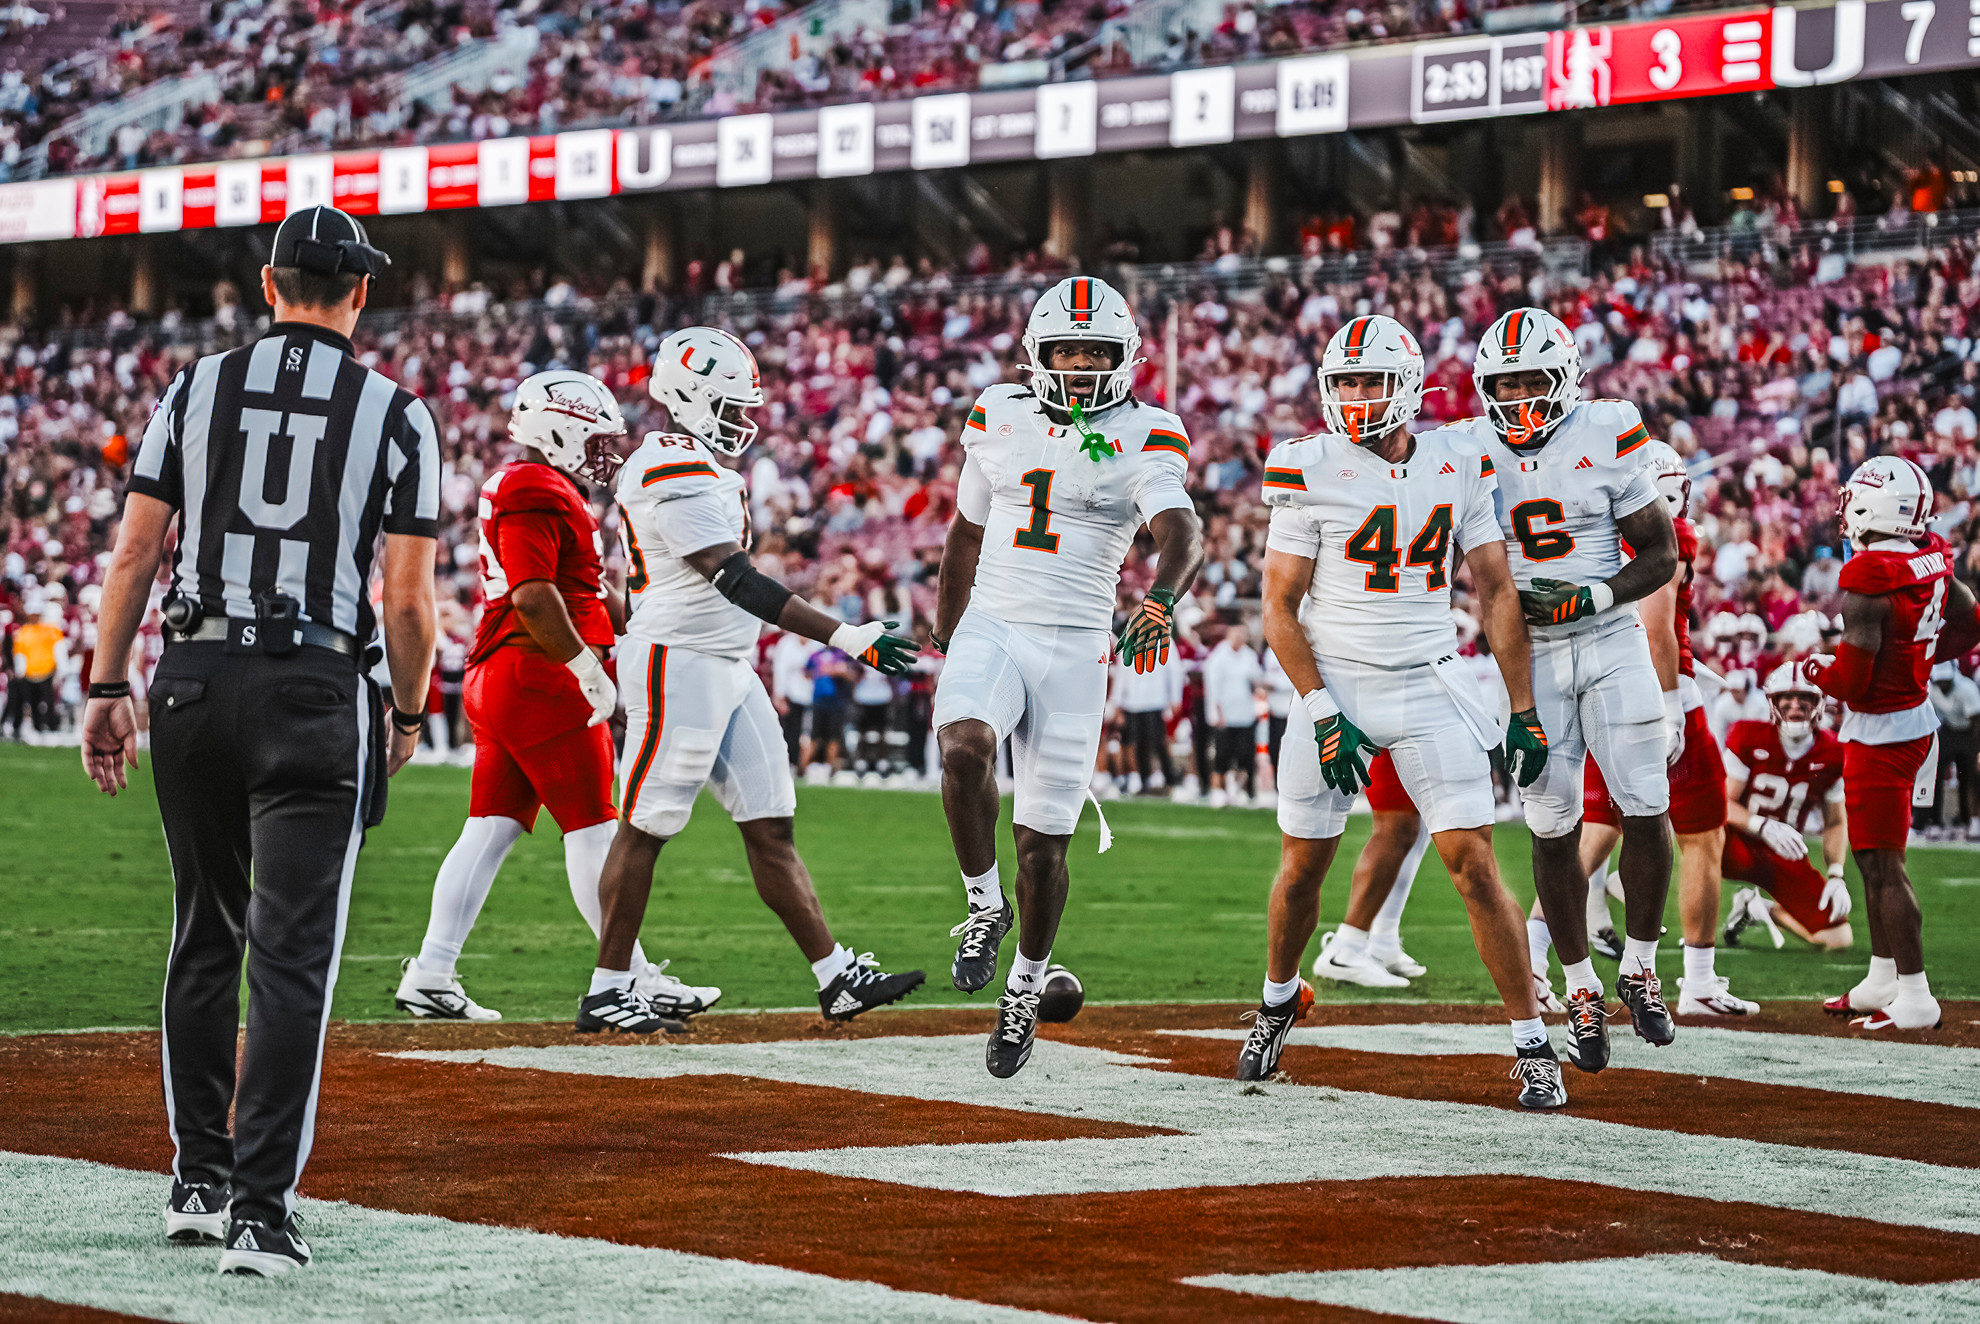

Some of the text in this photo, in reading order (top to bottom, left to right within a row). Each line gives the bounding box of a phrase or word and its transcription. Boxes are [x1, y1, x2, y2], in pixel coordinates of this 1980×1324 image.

[1772, 0, 1865, 87] U
[1901, 0, 1935, 64] 7
[1425, 60, 1487, 103] 2:53
[1502, 55, 1547, 92] 1ST
[1649, 29, 1682, 90] 3
[616, 129, 672, 189] U
[1070, 322, 1092, 330] ACC
[681, 346, 718, 376] U
[1502, 356, 1520, 364] ACC
[546, 388, 602, 416] Stanford
[658, 435, 696, 451] 63
[1520, 460, 1538, 472] U
[239, 407, 328, 531] U
[1390, 468, 1407, 479] U
[1013, 468, 1060, 554] 1
[1510, 497, 1575, 563] 6
[1345, 503, 1454, 593] 44
[241, 626, 256, 647] S
[1913, 577, 1946, 661] 4
[1748, 773, 1809, 829] 21
